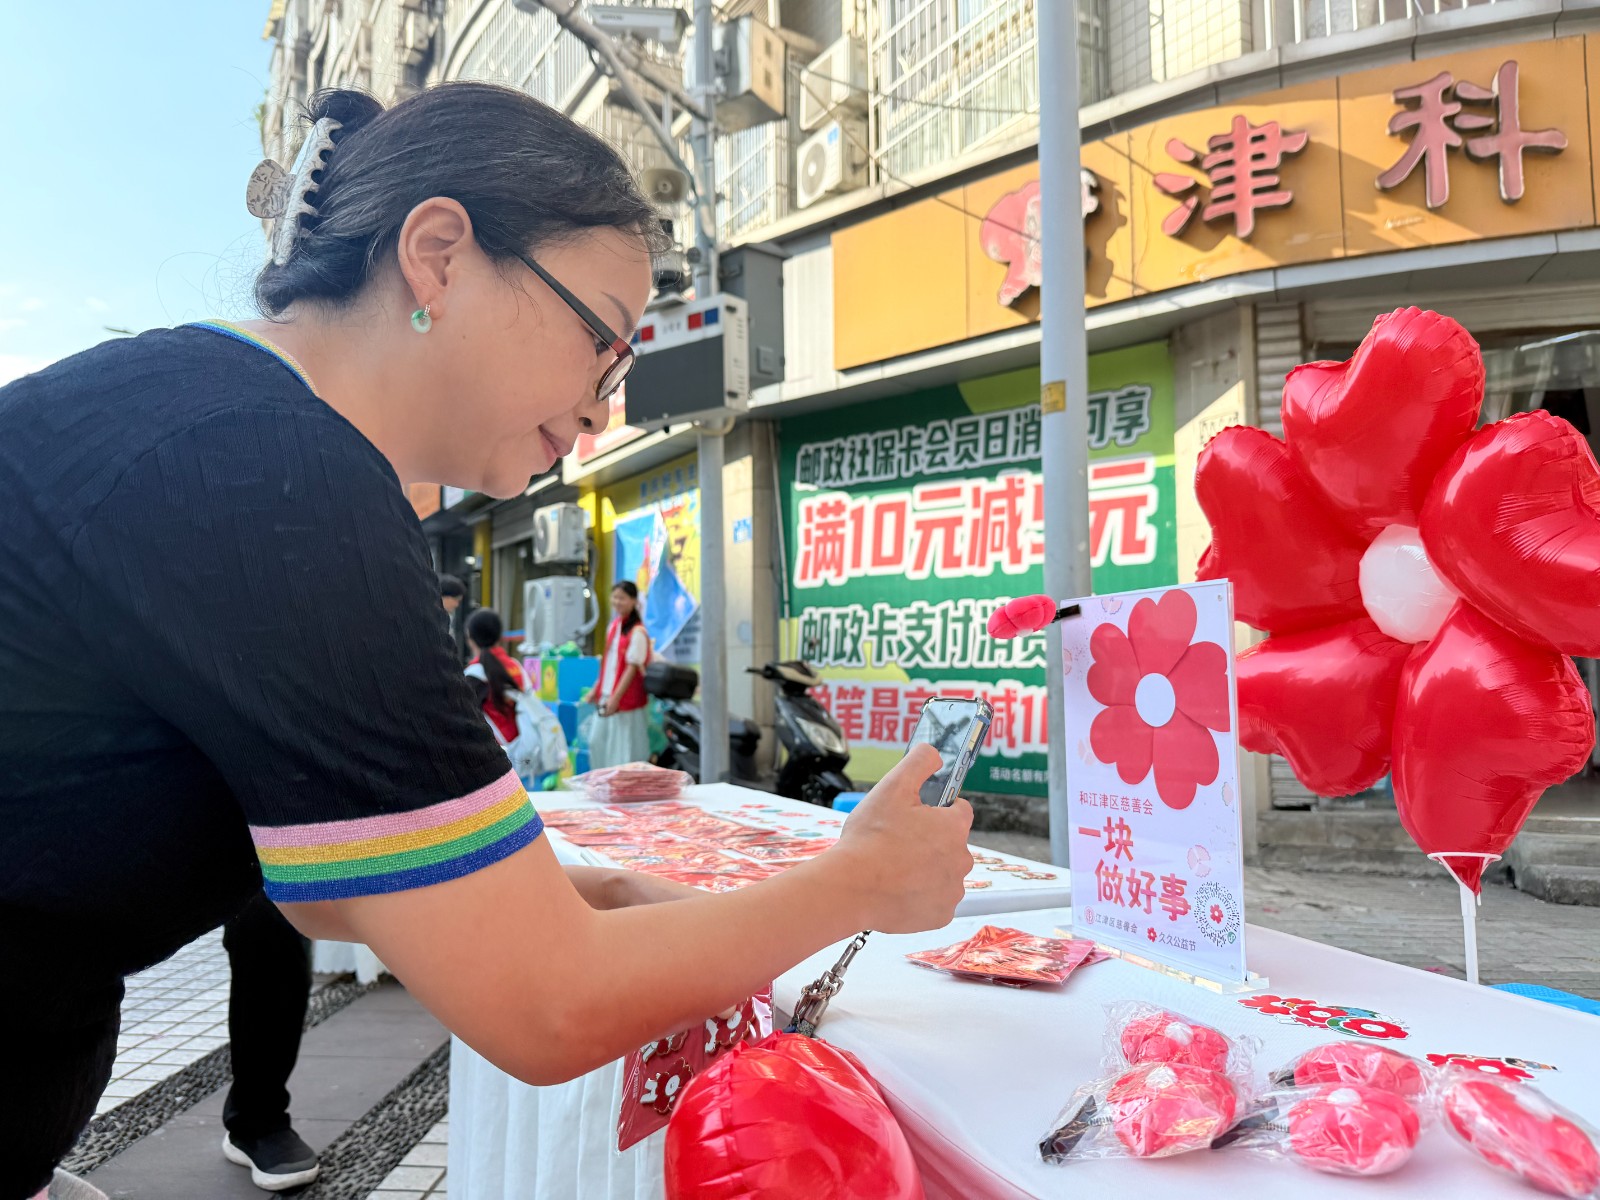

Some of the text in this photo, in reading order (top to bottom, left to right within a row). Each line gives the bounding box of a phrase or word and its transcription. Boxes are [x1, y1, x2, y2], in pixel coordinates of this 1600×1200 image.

[799, 388, 1148, 486] 邮政社保卡会员日消可享
[1079, 791, 1153, 816] 和江津区慈善会
[1078, 816, 1133, 861] 一块
[1094, 858, 1191, 921] 做好事
[1095, 913, 1138, 934] 江津区慈善会
[1158, 931, 1196, 952] 久久公益节
